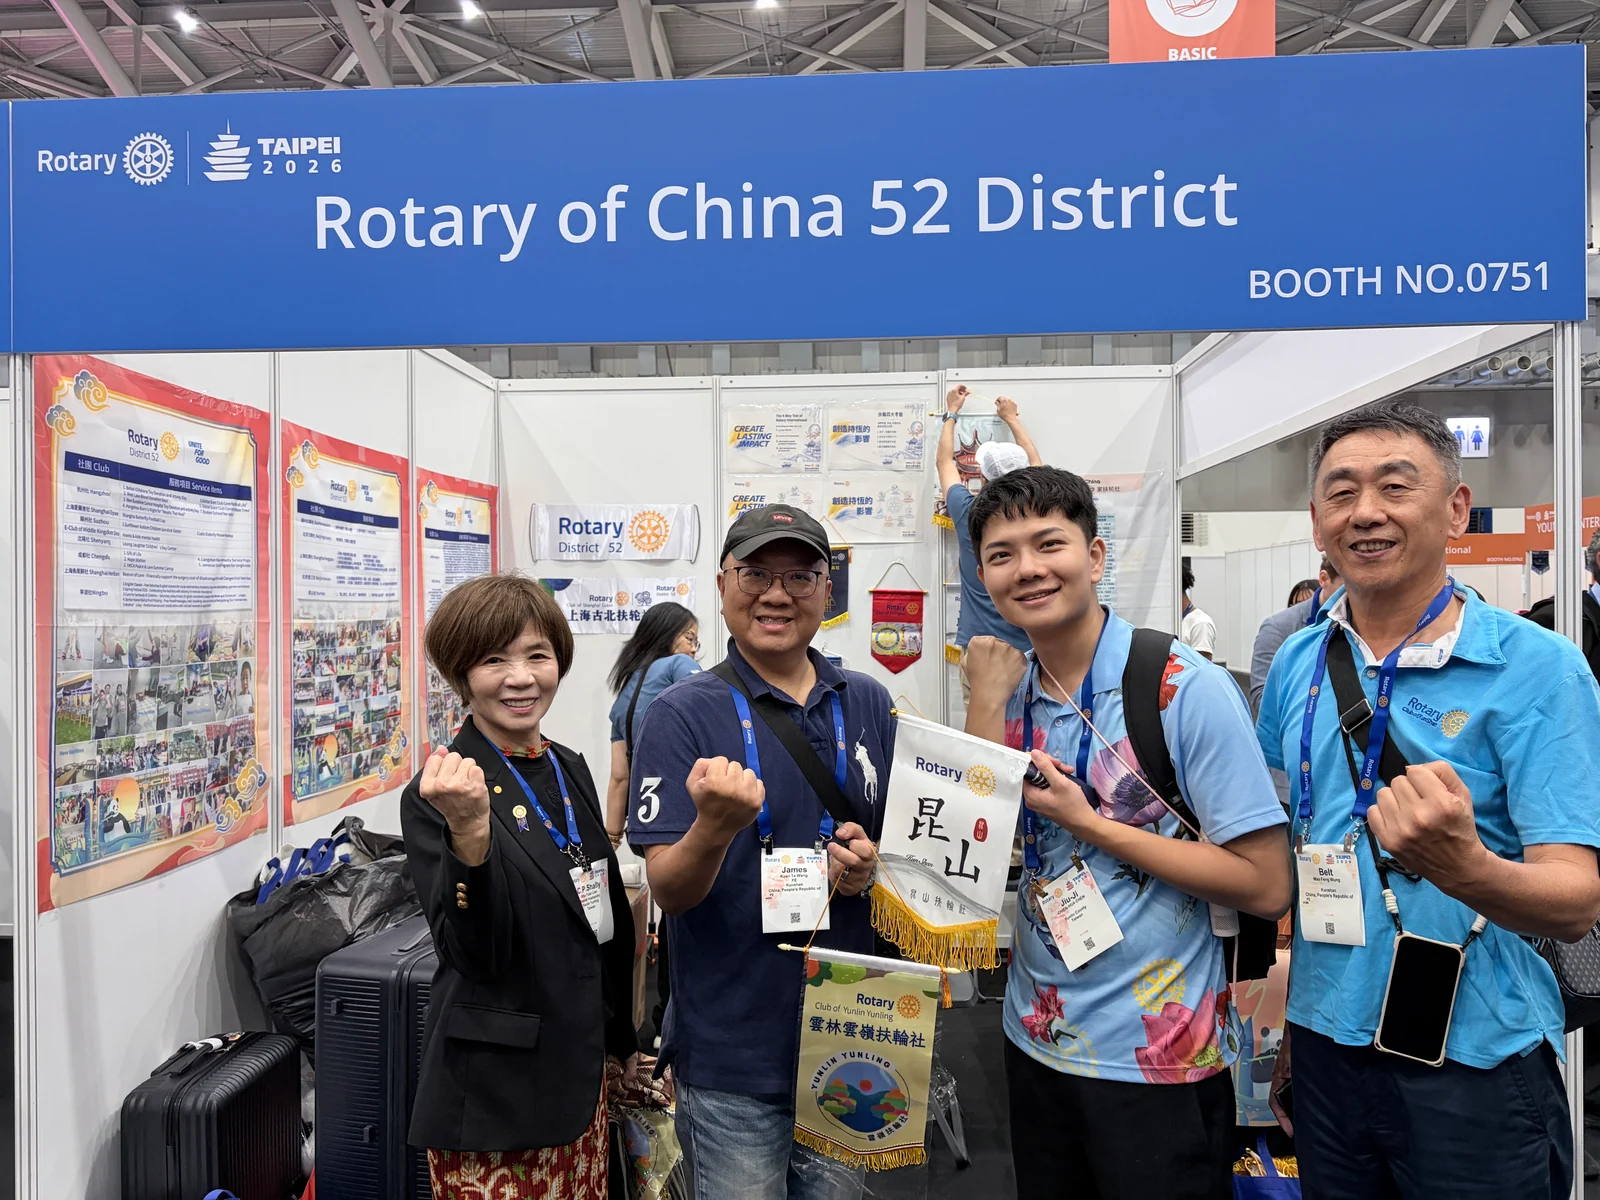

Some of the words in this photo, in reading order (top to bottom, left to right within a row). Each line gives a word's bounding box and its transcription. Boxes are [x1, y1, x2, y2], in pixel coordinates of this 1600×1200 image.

[1168, 47, 1217, 60] BASIC
[257, 136, 341, 155] TAIPEI
[38, 150, 117, 175] Rotary
[263, 158, 342, 174] 2026
[316, 196, 537, 262] Rotary
[558, 184, 629, 244] of
[648, 181, 843, 241] China
[871, 178, 950, 236] 52
[978, 169, 1238, 232] District
[1250, 266, 1381, 299] BOOTH
[1396, 261, 1549, 294] NO.0751
[128, 429, 158, 451] Rotary
[188, 440, 202, 449] UNITE
[130, 447, 150, 460] District
[152, 452, 159, 462] 52
[196, 456, 210, 465] GOOD
[93, 462, 110, 473] Club
[192, 482, 210, 493] Service
[210, 485, 222, 494] items
[331, 480, 347, 495] Rotary
[559, 517, 623, 539] Rotary
[559, 542, 600, 553] District
[608, 542, 622, 553] 52
[1445, 546, 1471, 554] tional
[589, 595, 613, 603] Rotary
[568, 609, 646, 622] 上海古北扶轮
[1382, 676, 1390, 695] Rotary
[1408, 697, 1444, 722] Rotary
[916, 757, 962, 783] Rotary
[1365, 758, 1374, 778] Rotary
[638, 777, 662, 823] 3
[1319, 868, 1333, 876] Belt
[1042, 895, 1055, 905] Rotary
[1061, 890, 1078, 907] Jiu-Ji
[1071, 913, 1083, 922] Taiwan
[1075, 905, 1087, 914] County
[856, 993, 895, 1011] Rotary
[815, 1002, 831, 1011] Club
[843, 1007, 865, 1017] Yunlin
[867, 1009, 894, 1022] Yunling
[809, 1016, 926, 1048] 雲林雲嶺扶輪社
[811, 1057, 837, 1090] YUNLIN
[841, 1051, 891, 1069] YUNLING
